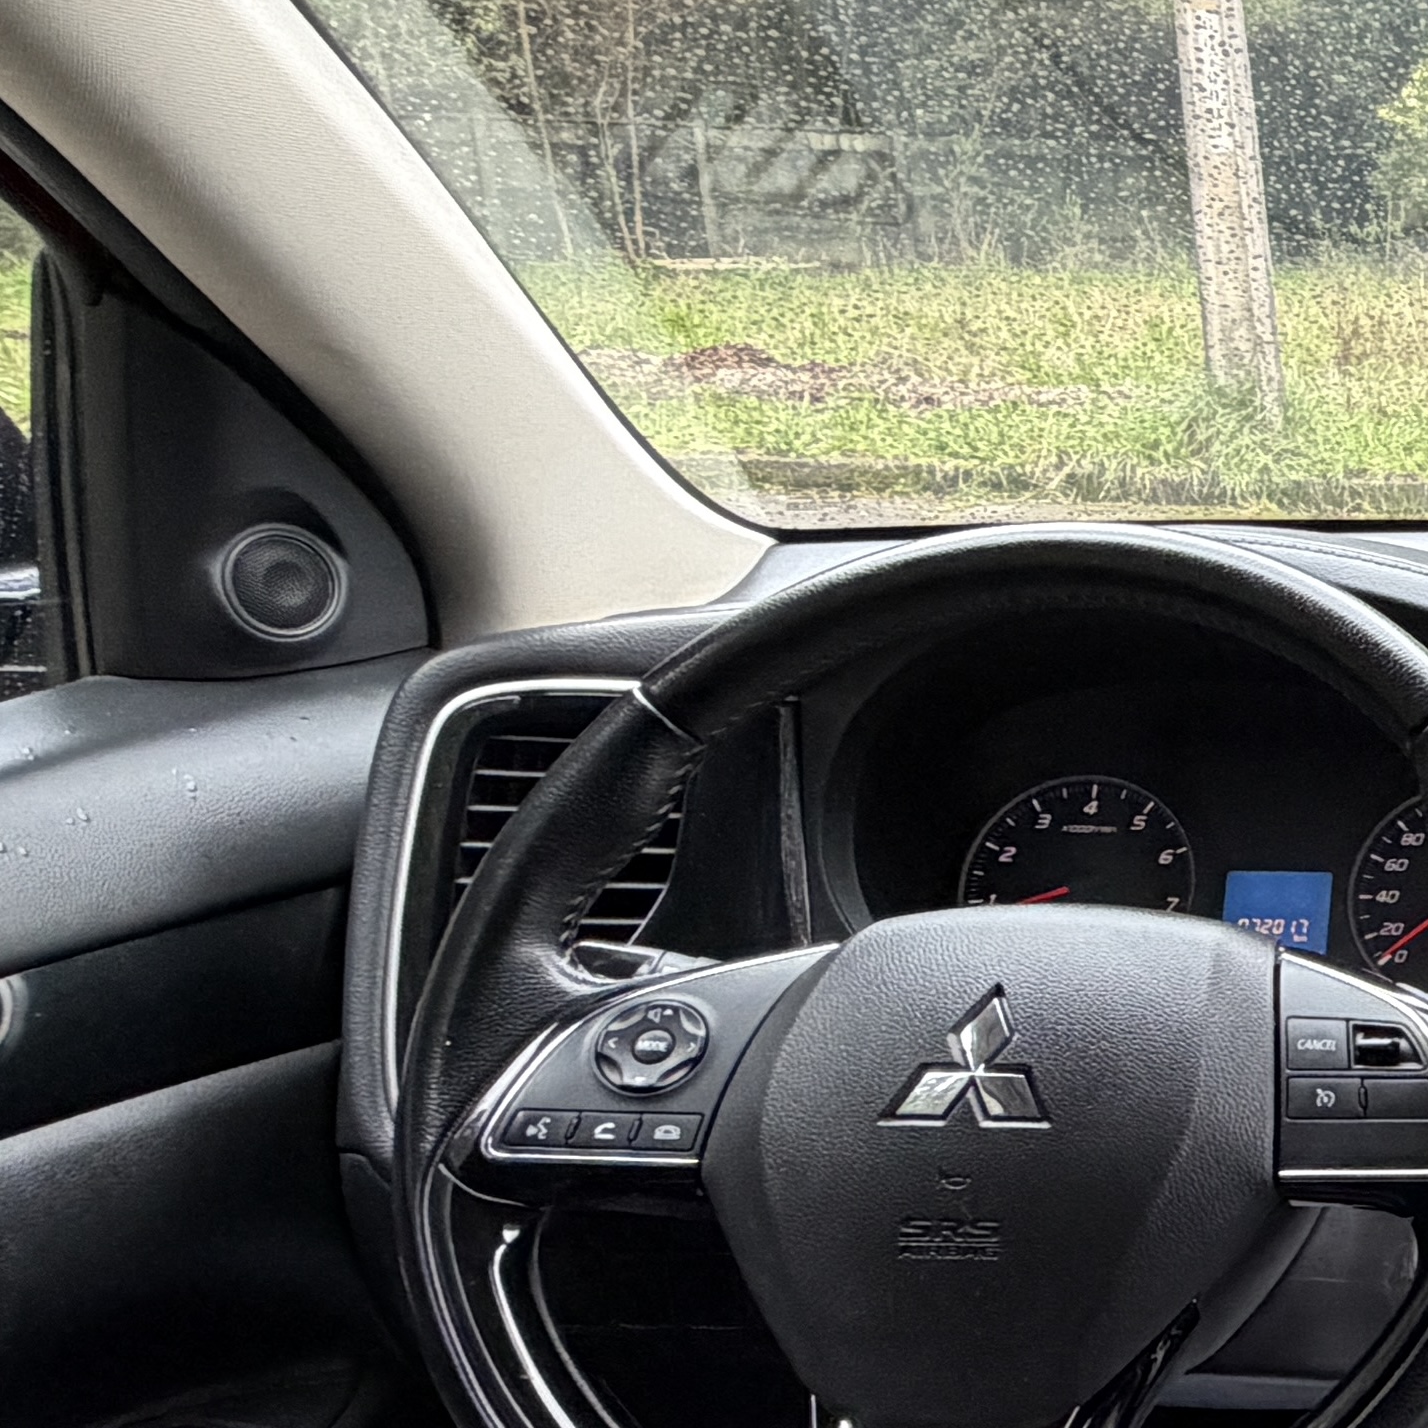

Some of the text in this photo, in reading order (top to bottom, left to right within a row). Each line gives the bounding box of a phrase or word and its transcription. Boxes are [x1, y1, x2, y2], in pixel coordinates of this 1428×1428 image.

[1083, 800, 1099, 816] 4
[1034, 813, 1052, 829] 3
[1130, 815, 1148, 830] 5
[1400, 832, 1426, 846] 80
[997, 846, 1017, 862] 2
[1158, 849, 1175, 864] 6
[1384, 858, 1409, 872] 60
[1375, 889, 1401, 904] 40
[1165, 897, 1180, 912] 7
[1379, 922, 1405, 936] 20
[1394, 949, 1408, 963] 0
[1297, 1037, 1338, 1054] CANCEL
